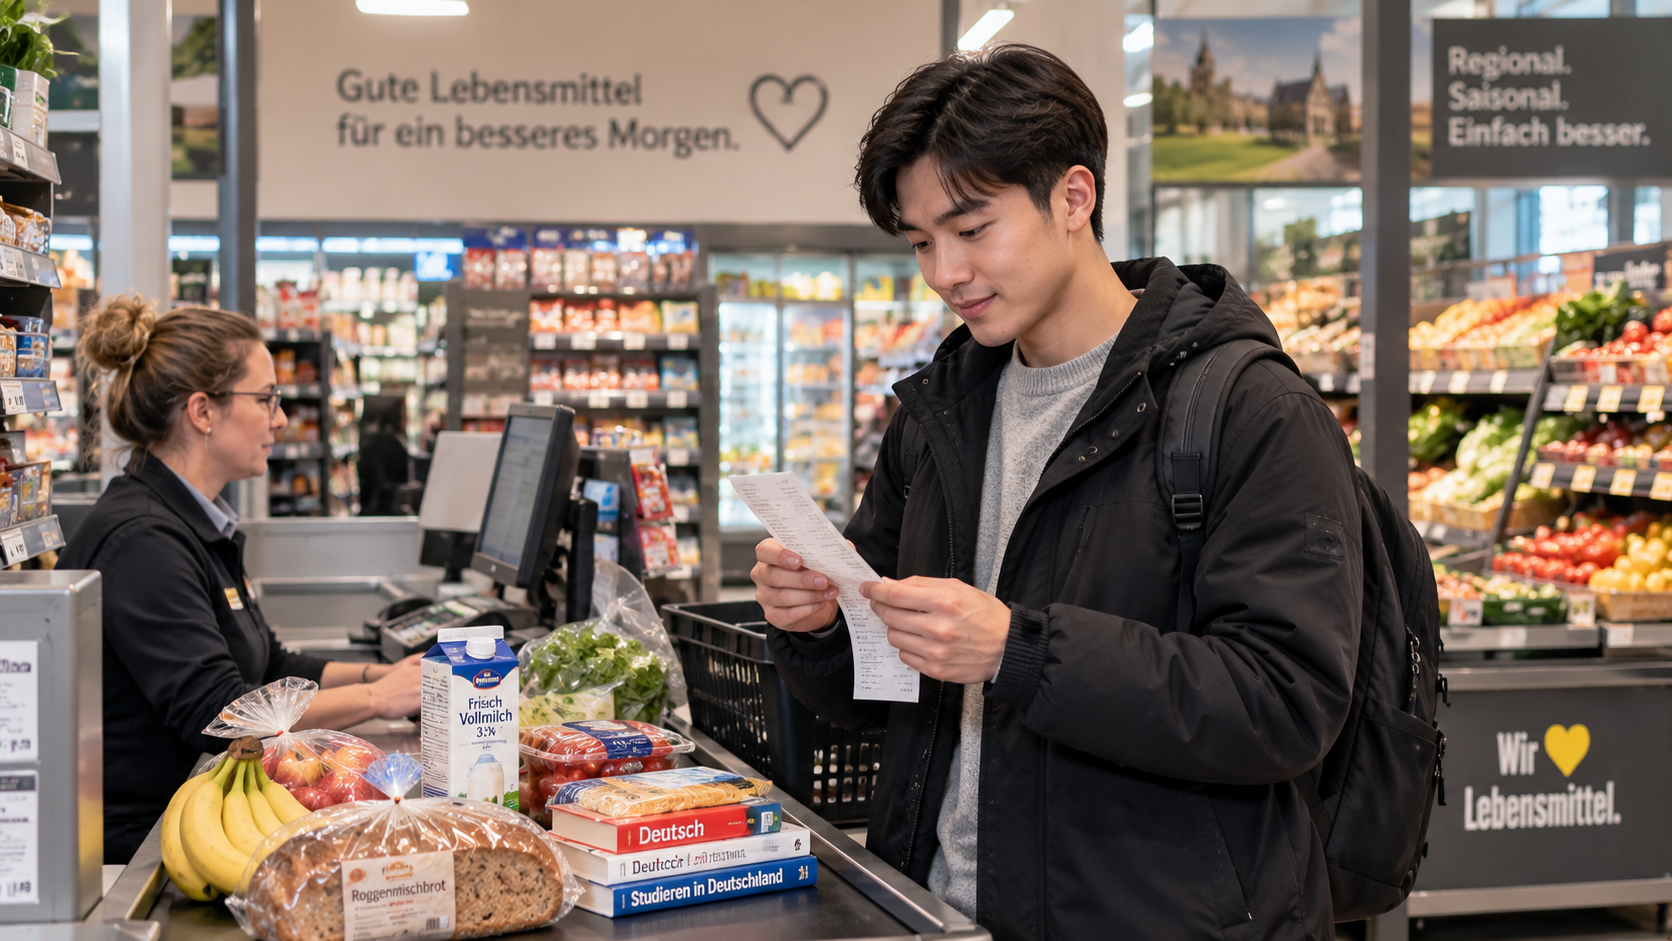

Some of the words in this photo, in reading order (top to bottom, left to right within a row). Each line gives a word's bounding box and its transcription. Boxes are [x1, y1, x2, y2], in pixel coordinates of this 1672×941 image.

[1448, 44, 1572, 81] Regional.
[336, 68, 420, 104] Gute
[429, 70, 642, 106] Lebensmittel
[1448, 79, 1569, 111] Saisonal.
[336, 112, 386, 148] für
[395, 115, 444, 149] ein
[456, 114, 598, 150] besseres
[608, 118, 740, 160] Morgen.
[1448, 116, 1549, 147] Einfach
[1556, 116, 1651, 147] besser.
[459, 708, 513, 726] Vollmilch
[1496, 731, 1539, 776] Wir
[1463, 780, 1621, 831] Lebensmittel.
[639, 819, 704, 845] Deutsch
[351, 879, 446, 903] Roggenmischbrot
[631, 885, 690, 907] Studieren
[693, 880, 705, 897] in
